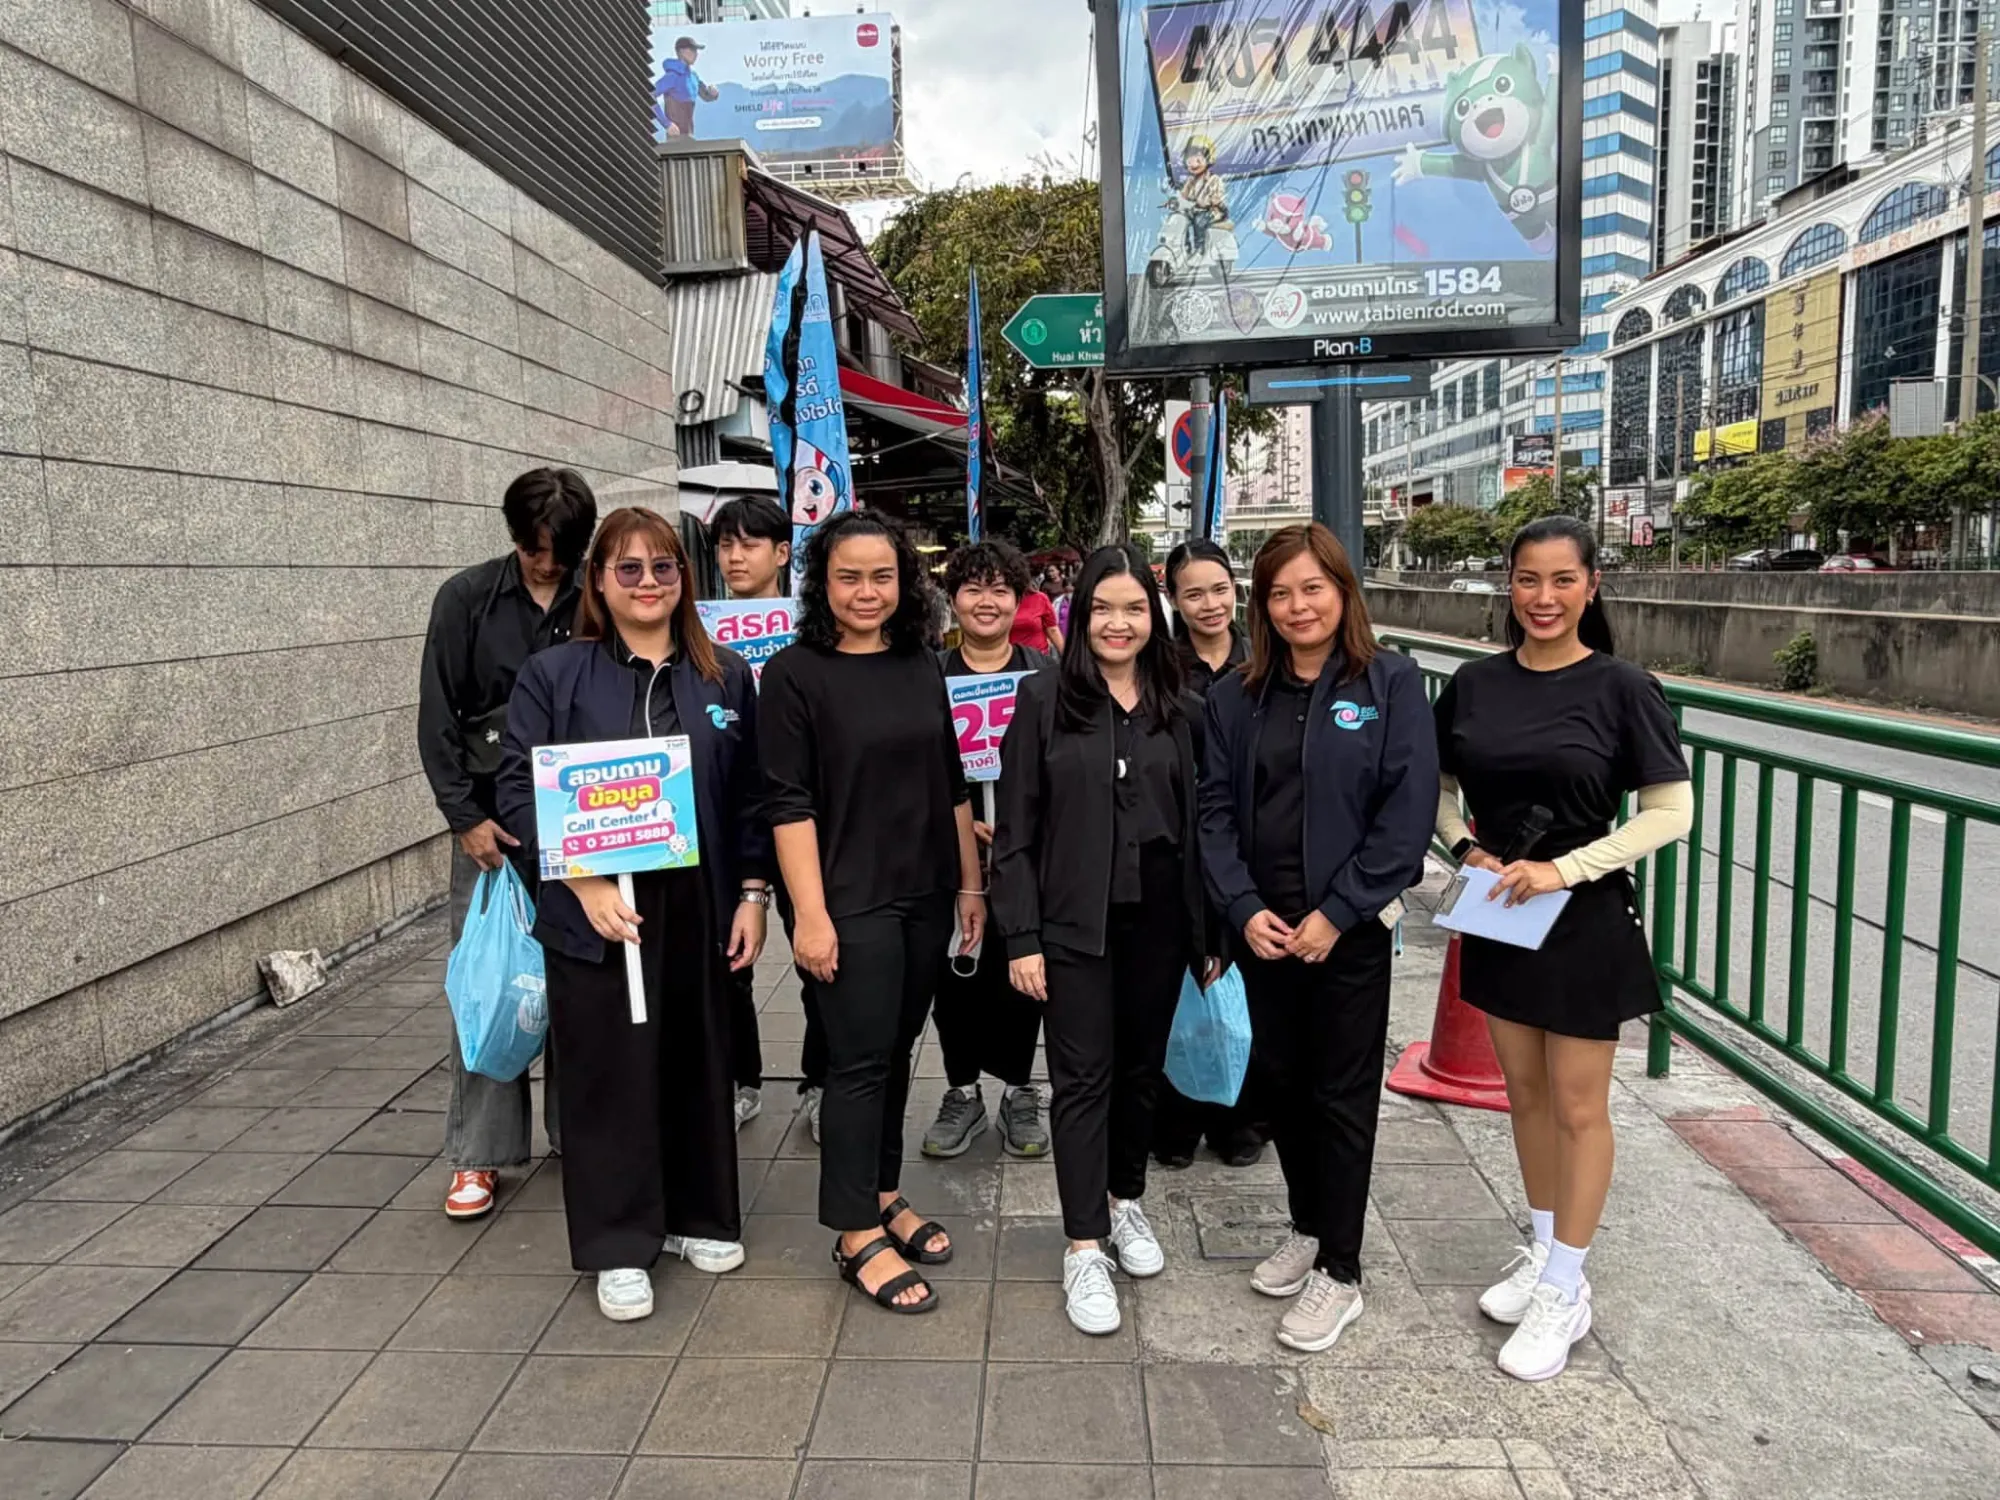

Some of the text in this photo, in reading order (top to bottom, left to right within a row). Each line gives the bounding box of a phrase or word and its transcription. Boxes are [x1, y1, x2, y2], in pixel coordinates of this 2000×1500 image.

[743, 52, 824, 69] Worry Free
[1312, 265, 1502, 299] สอบถามโทร 1584
[1312, 299, 1506, 325] www.tabienrod.com
[1079, 319, 1102, 344] ห้ว
[1052, 350, 1104, 362] Huai Khwa
[796, 376, 819, 398] รดี
[952, 695, 1016, 754] 25
[567, 758, 662, 788] สอบถาม
[587, 784, 654, 810] ข้อมูล
[567, 812, 650, 834] Call Center
[586, 838, 597, 849] 0
